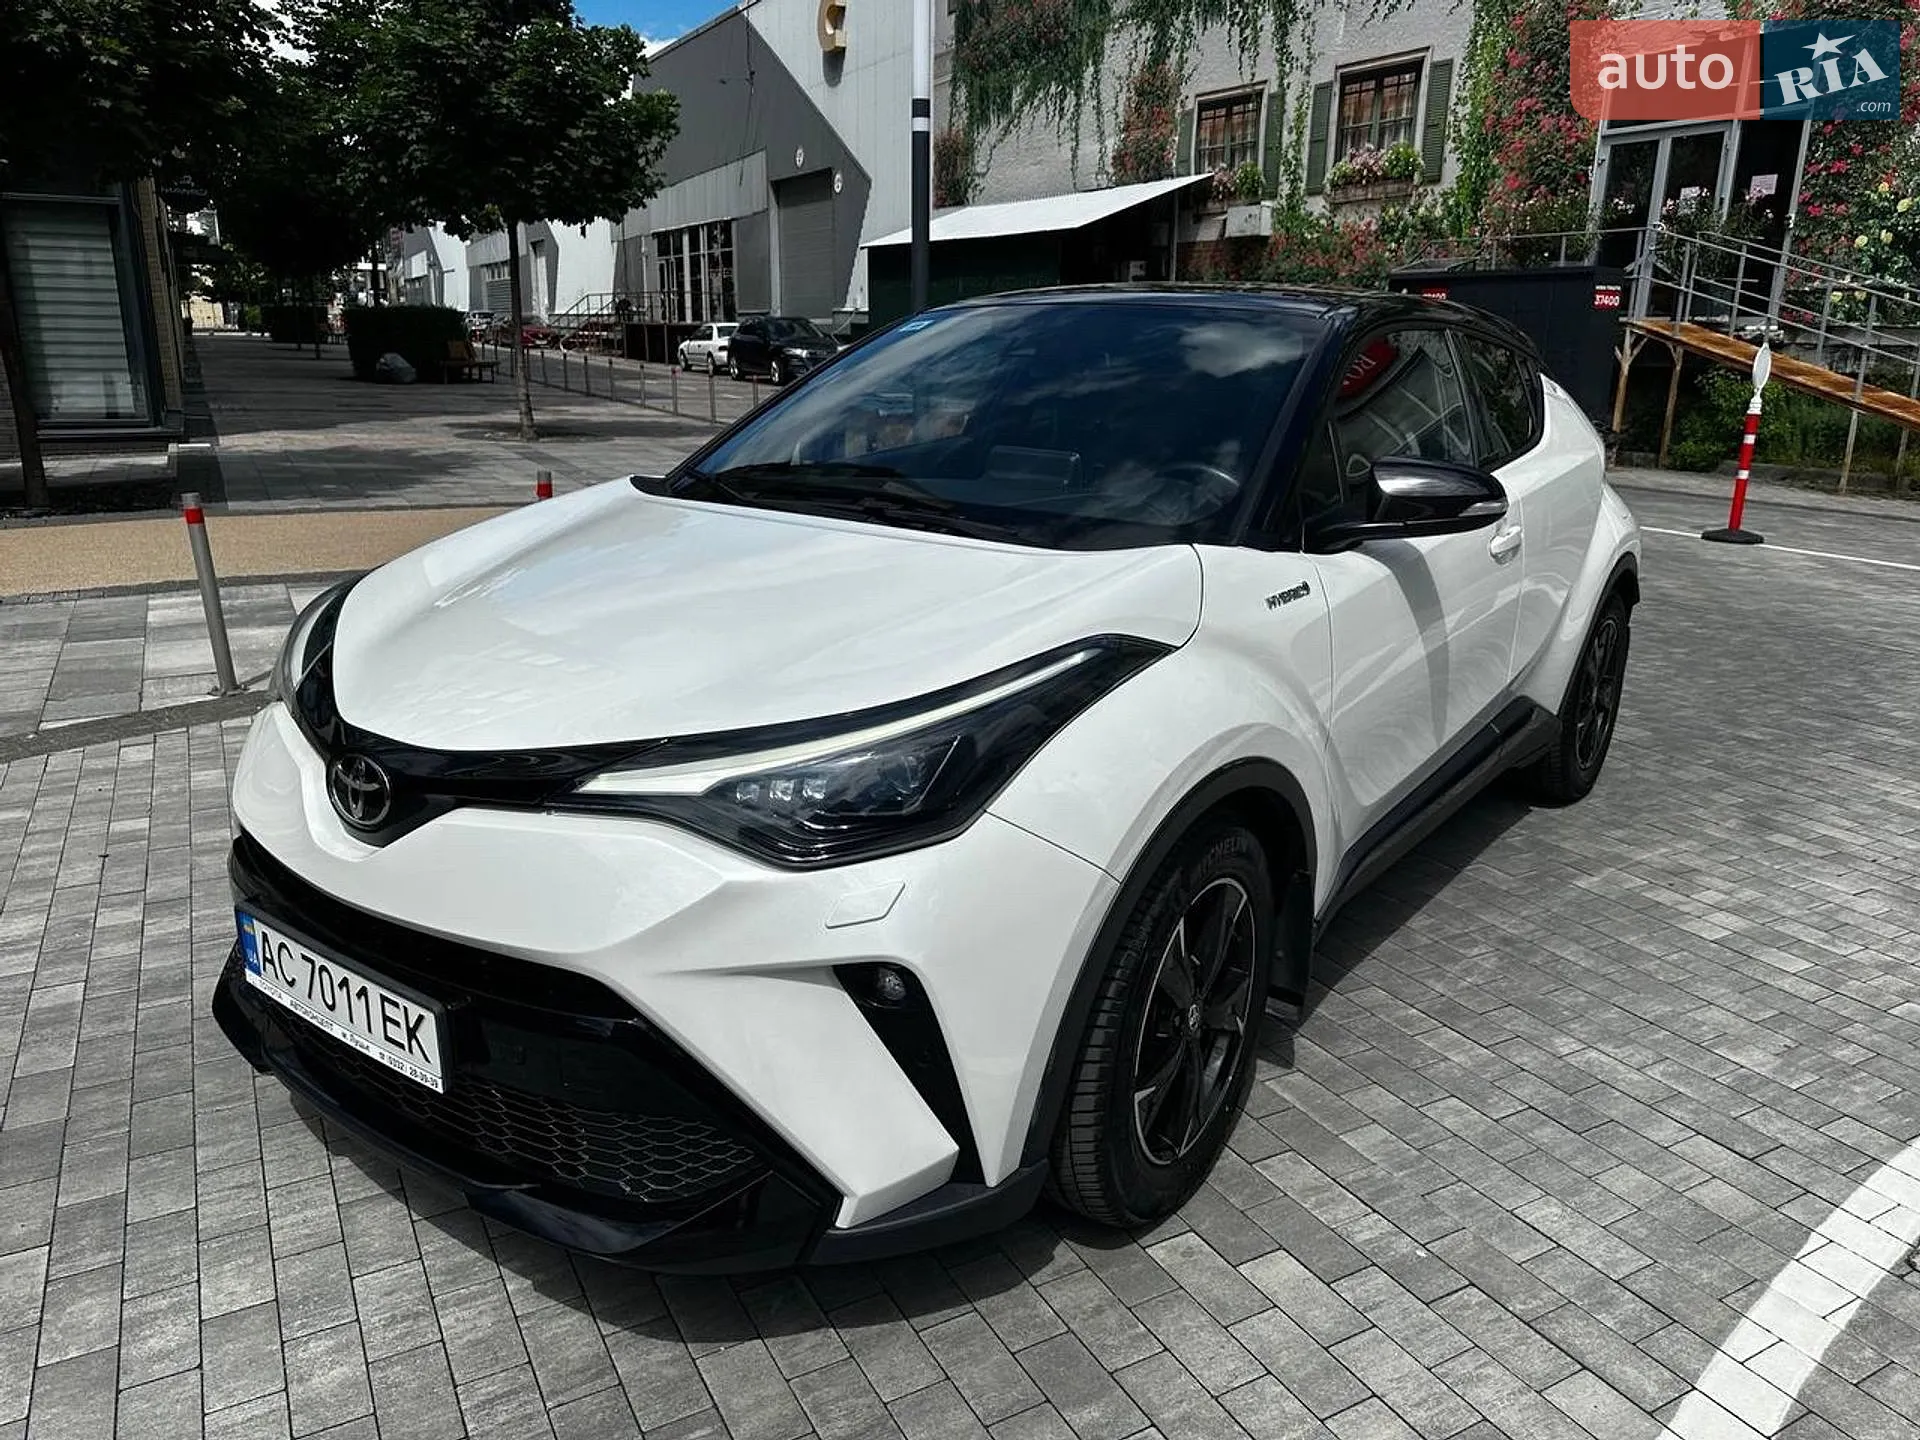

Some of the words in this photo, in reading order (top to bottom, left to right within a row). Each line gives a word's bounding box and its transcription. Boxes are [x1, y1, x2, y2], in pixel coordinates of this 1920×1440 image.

[1594, 294, 1621, 307] 37400
[261, 931, 297, 988] AC
[300, 952, 373, 1035] 7011
[379, 993, 432, 1065] EK
